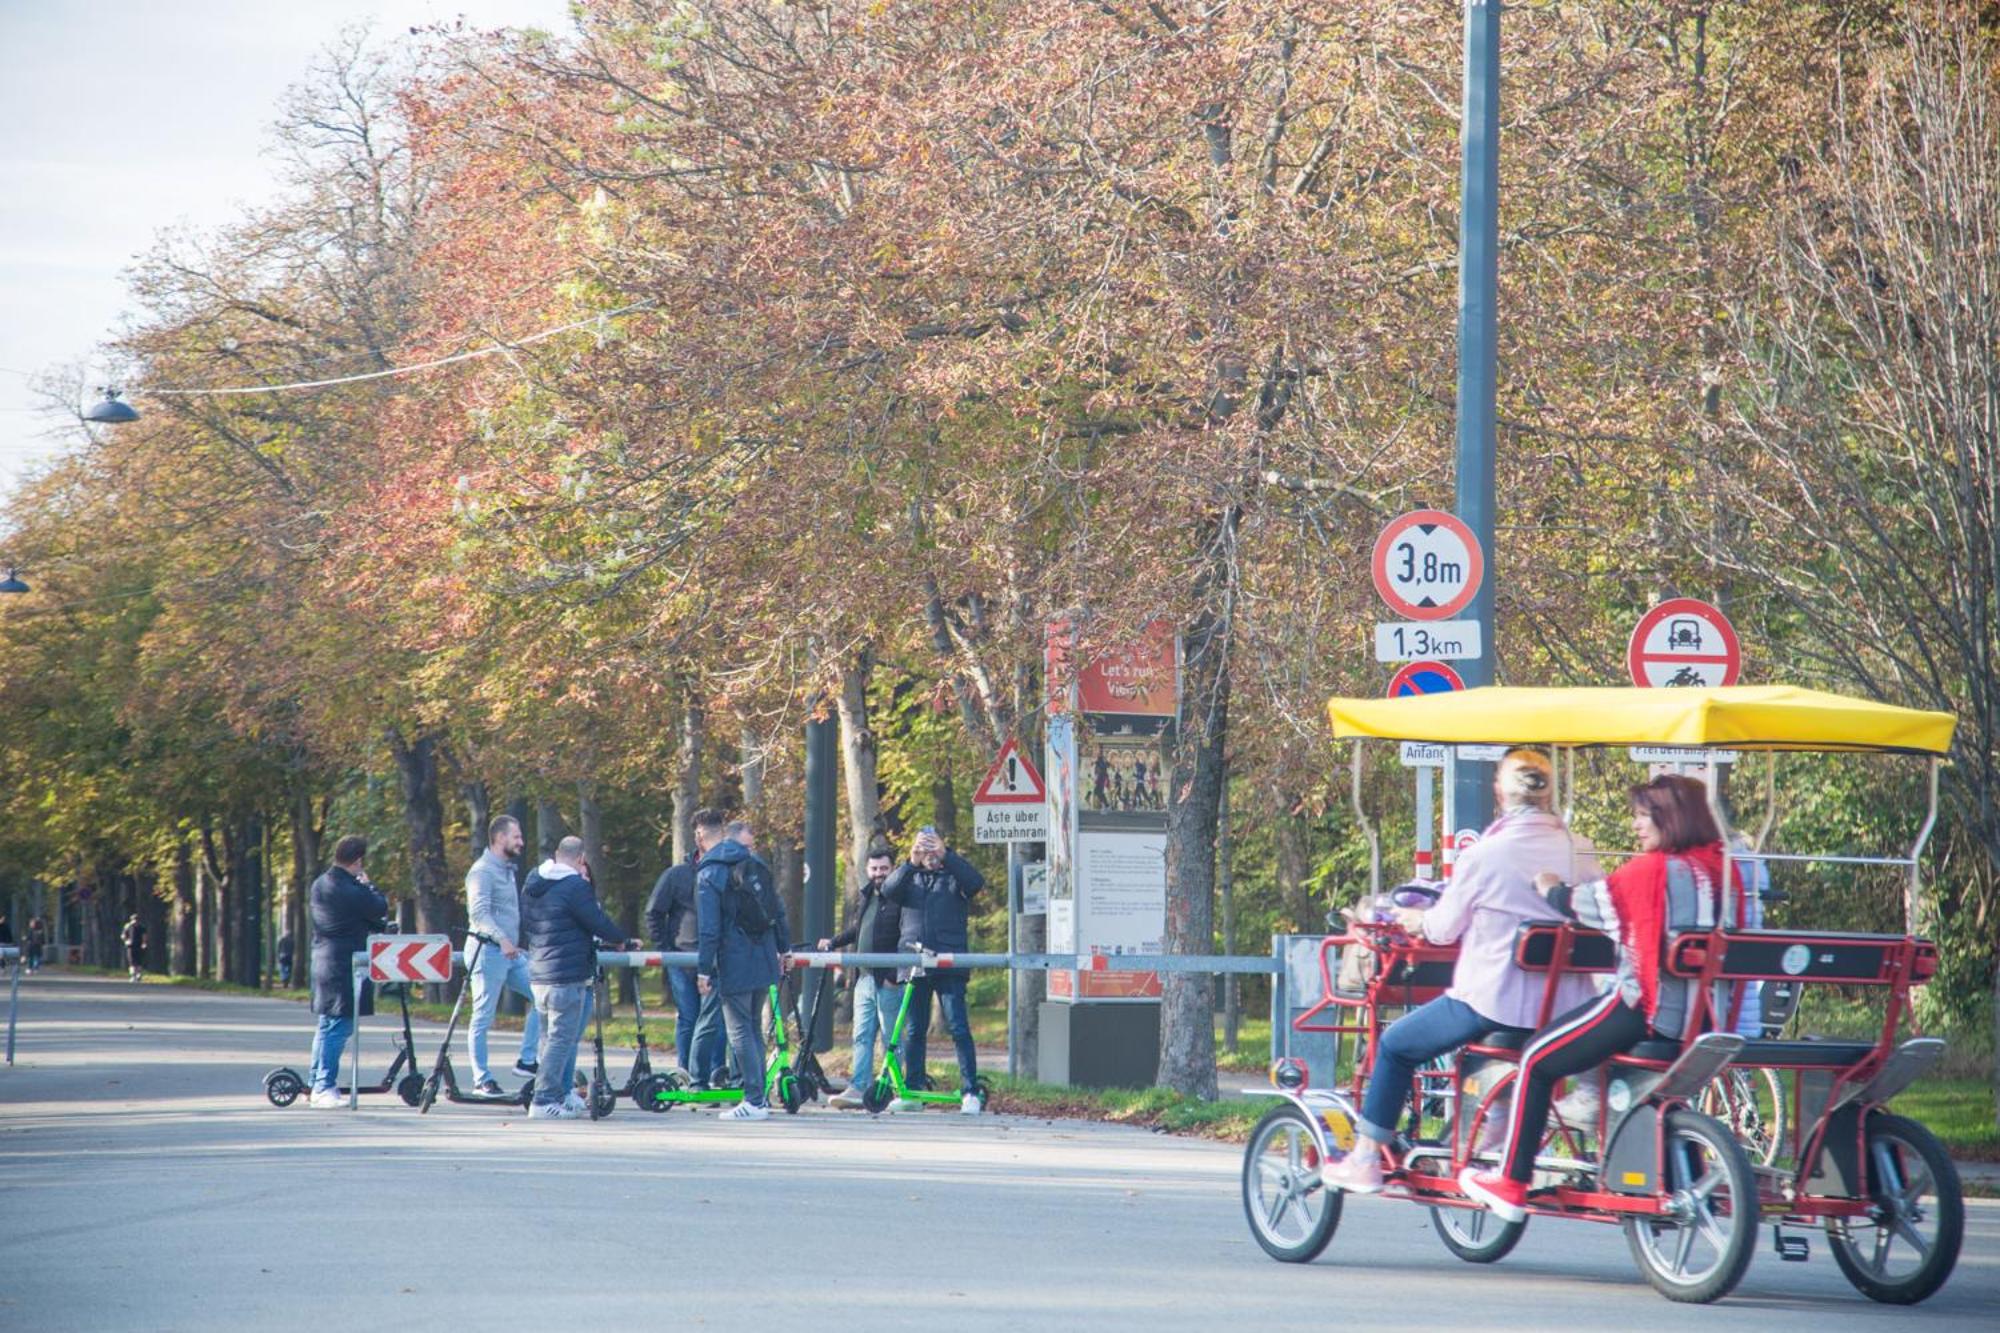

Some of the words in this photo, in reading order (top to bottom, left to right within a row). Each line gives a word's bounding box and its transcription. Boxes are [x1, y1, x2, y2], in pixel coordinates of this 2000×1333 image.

[1397, 542, 1461, 586] 3,8m
[1393, 627, 1462, 658] 1,3km
[1101, 662, 1130, 677] Let's
[987, 809, 1011, 823] Äste
[1015, 809, 1039, 823] über
[976, 826, 1046, 840] Fahrbahnran
